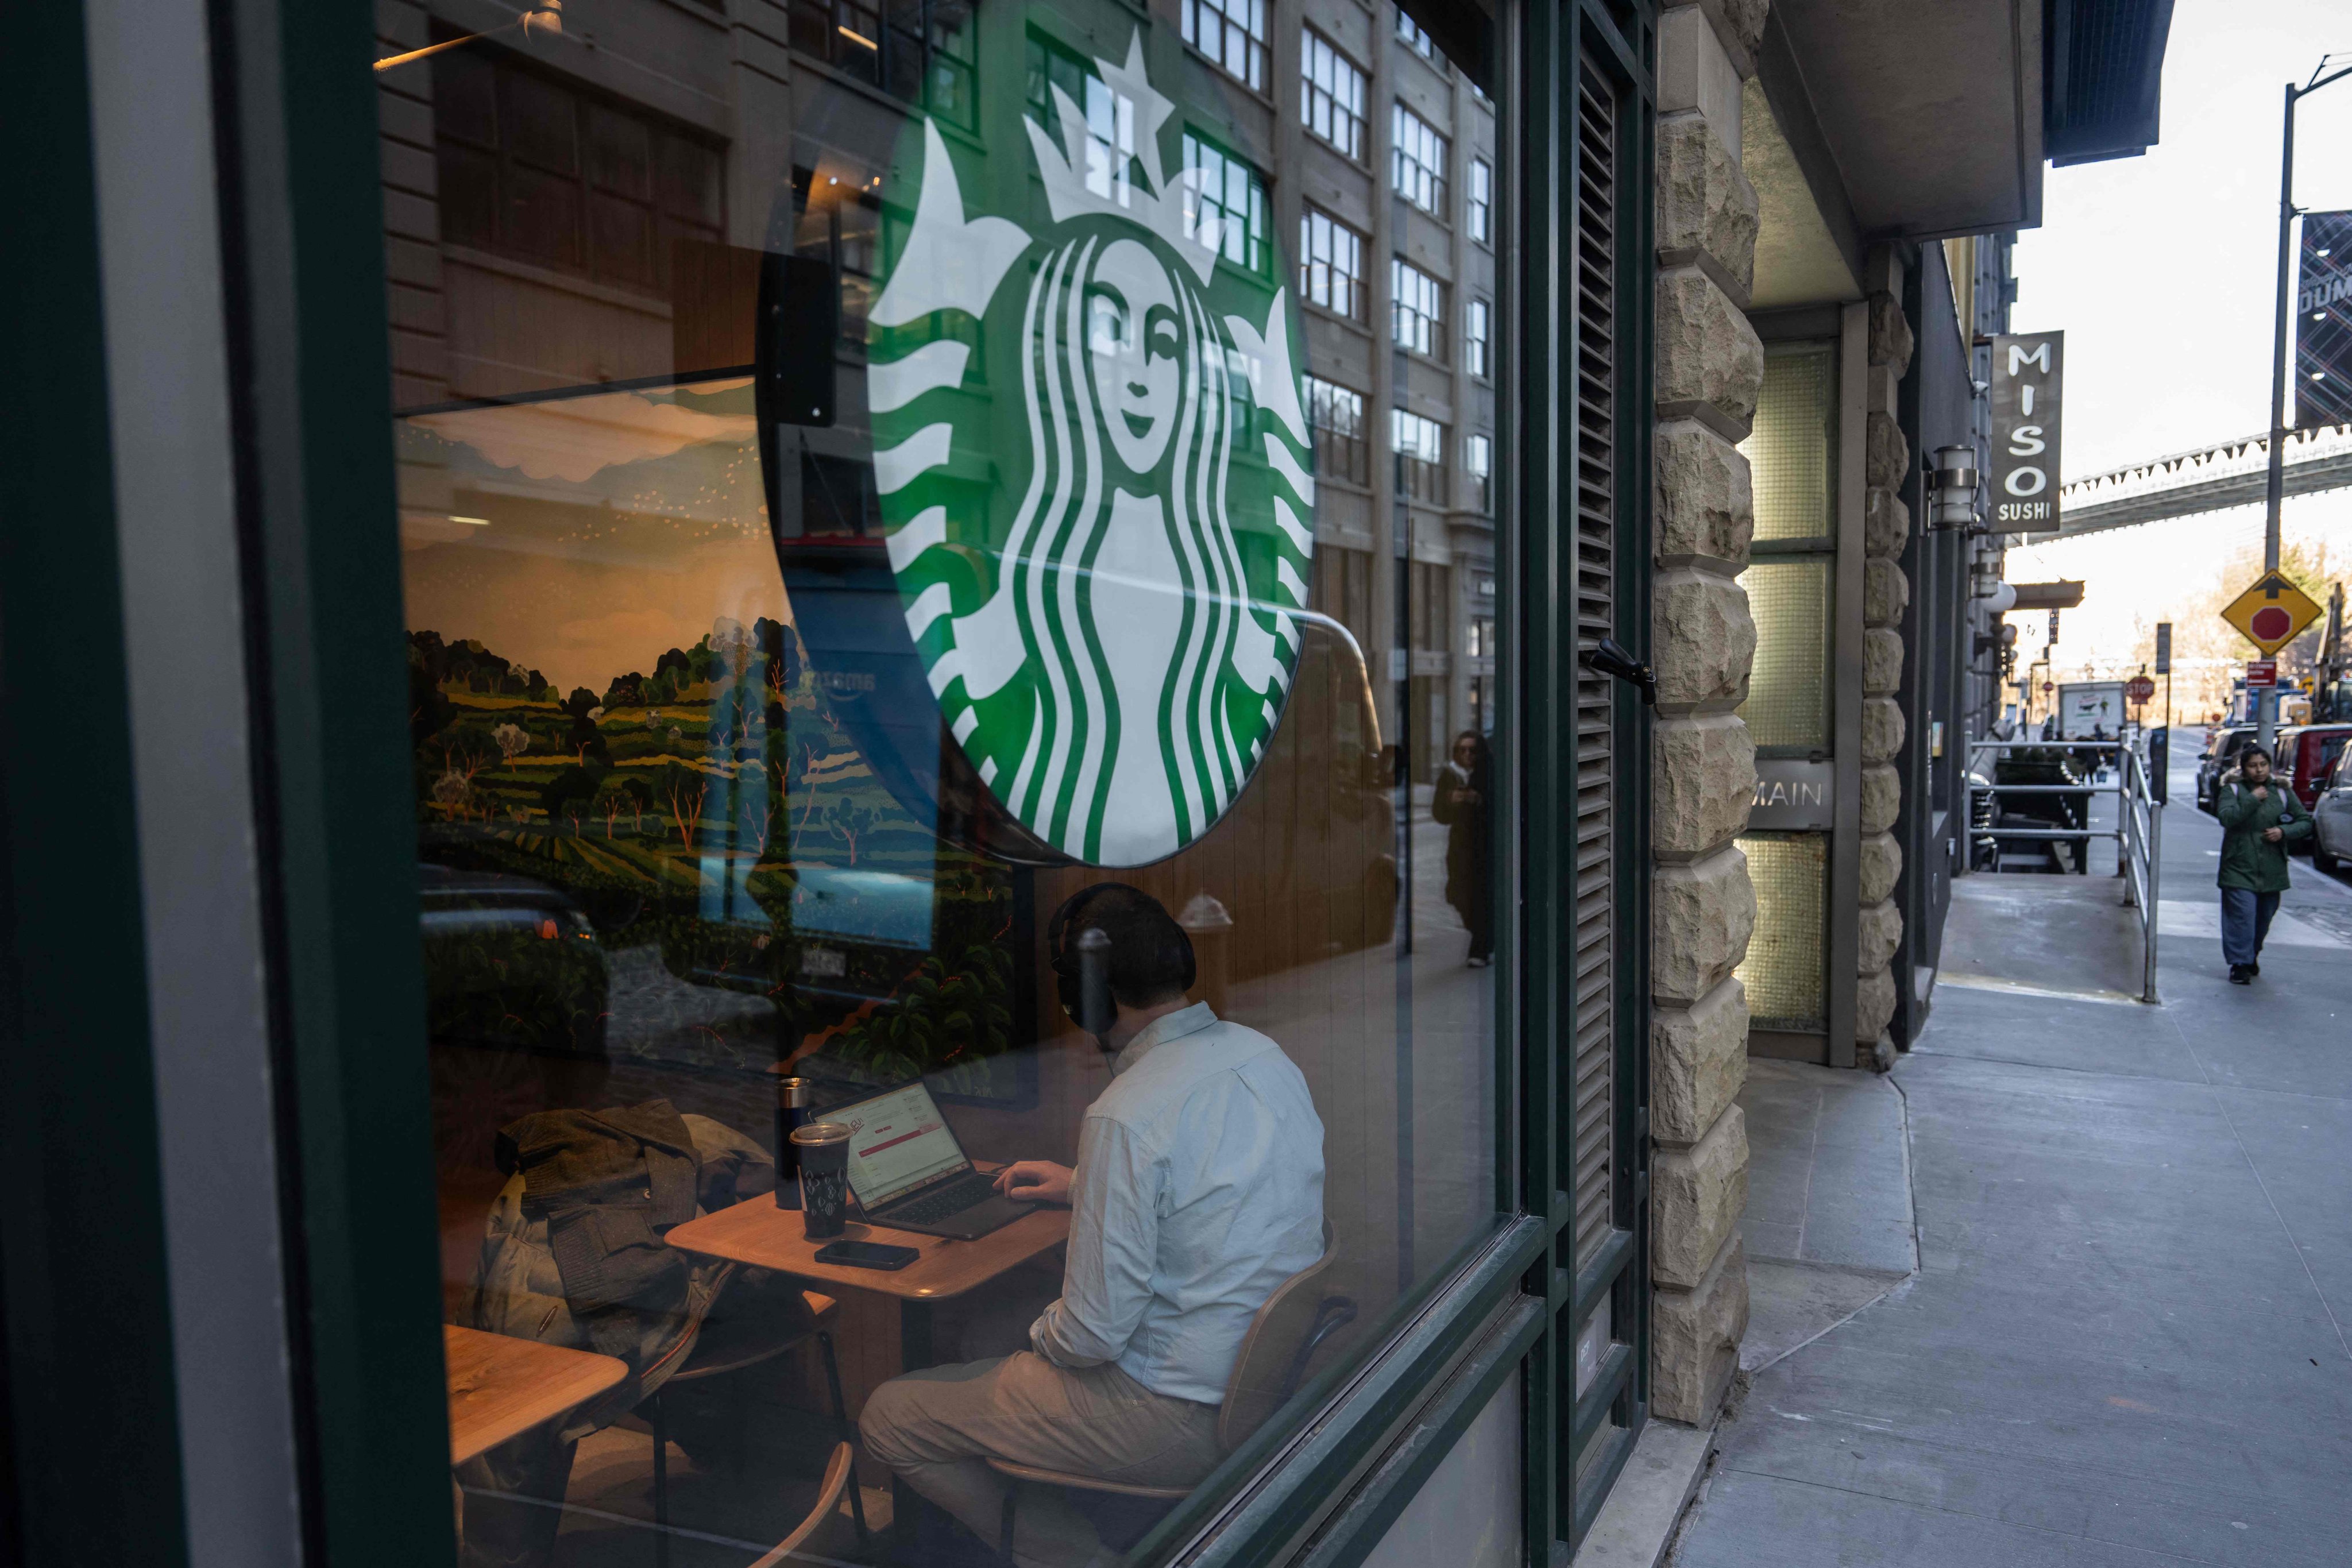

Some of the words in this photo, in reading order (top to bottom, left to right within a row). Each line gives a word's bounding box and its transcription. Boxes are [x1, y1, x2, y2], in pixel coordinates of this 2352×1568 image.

[2005, 342, 2051, 497] MISO
[1998, 501, 2050, 521] SUSHI
[2126, 683, 2153, 694] STOP
